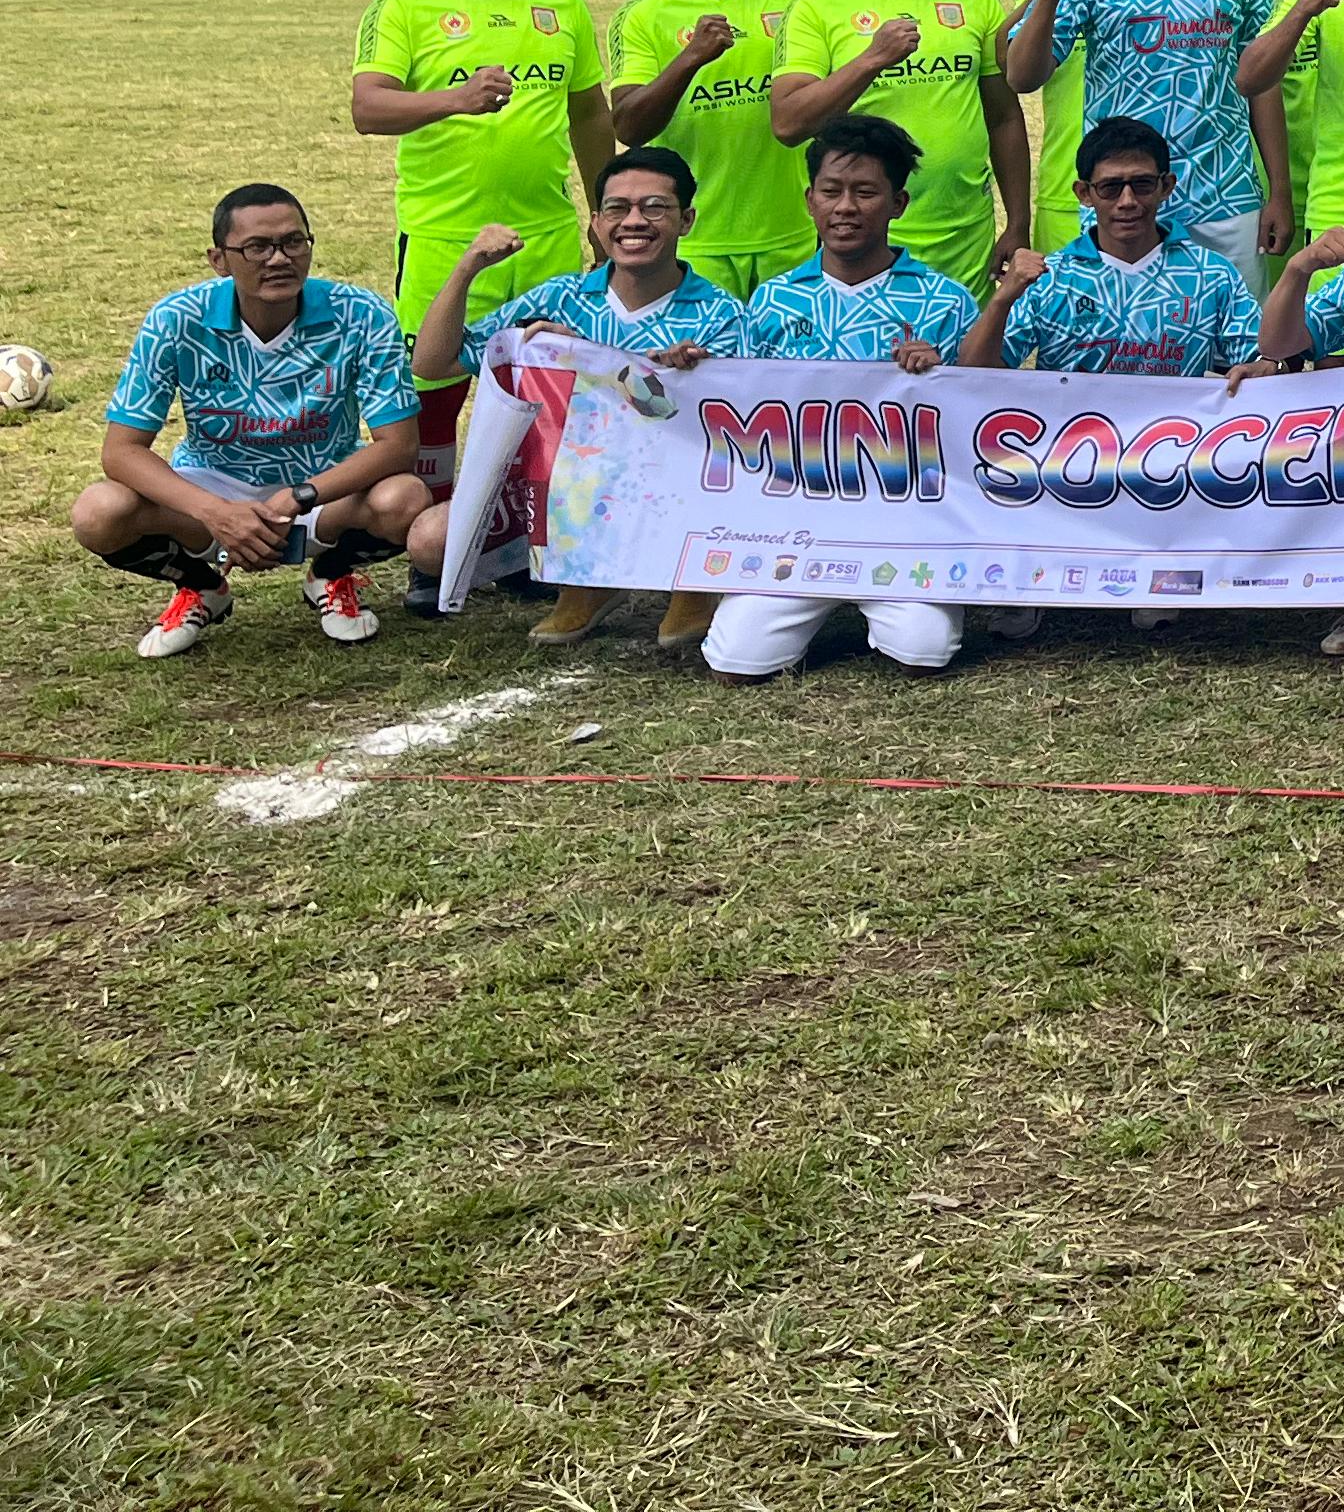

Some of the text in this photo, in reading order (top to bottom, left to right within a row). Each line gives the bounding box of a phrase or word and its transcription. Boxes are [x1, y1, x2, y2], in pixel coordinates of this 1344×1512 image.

[1128, 8, 1233, 54] Jurnalis
[448, 63, 565, 86] AKAB
[876, 55, 973, 79] SKAB
[689, 73, 771, 104] ASKA
[693, 94, 770, 113] PSSI WONO
[699, 399, 946, 502] MINI
[706, 526, 817, 550] Sponsored By
[826, 563, 858, 575] PSSI
[1099, 568, 1138, 584] AQUA
